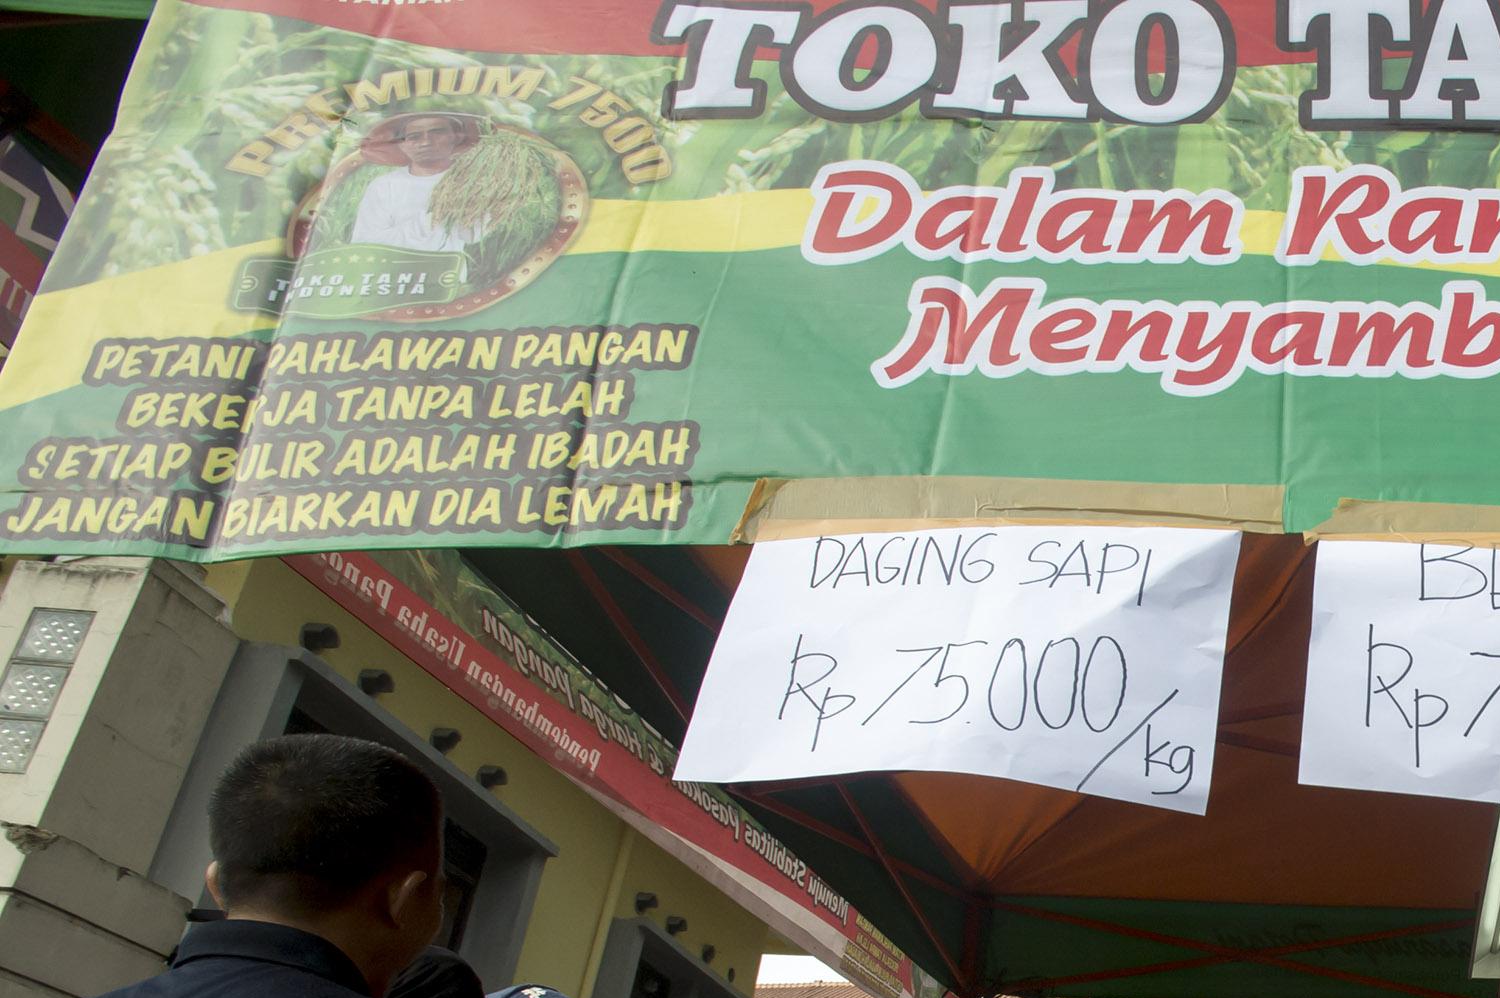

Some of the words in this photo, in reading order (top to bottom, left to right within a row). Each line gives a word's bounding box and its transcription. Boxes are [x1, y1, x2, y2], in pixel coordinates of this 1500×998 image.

[662, 0, 1227, 122] TOKO
[224, 66, 546, 178] PREMIUM
[546, 75, 674, 186] 7500
[811, 170, 1234, 256] Dalam
[267, 284, 426, 302] INDONESIA
[275, 274, 344, 291] TOKO
[361, 272, 428, 285] TANI
[94, 345, 257, 381] PETANI
[266, 335, 503, 375] PAHLAWAN
[510, 330, 690, 369] PANGAN
[126, 389, 318, 433] BEKERJA
[336, 383, 474, 422] TANPA
[487, 377, 626, 420] LELAH
[28, 441, 193, 481] SETIAP
[200, 440, 326, 484] BULIR
[332, 432, 518, 477] ADALAH
[526, 426, 691, 471] IBADAH
[6, 495, 217, 541] JANGAN
[221, 489, 421, 538] BIARKAN
[428, 486, 502, 526] DIA
[516, 481, 683, 527] LEMAH
[808, 532, 998, 588] DAGING
[1018, 540, 1152, 607] SAPI
[778, 634, 856, 752] Rp
[1366, 623, 1449, 768] Rp
